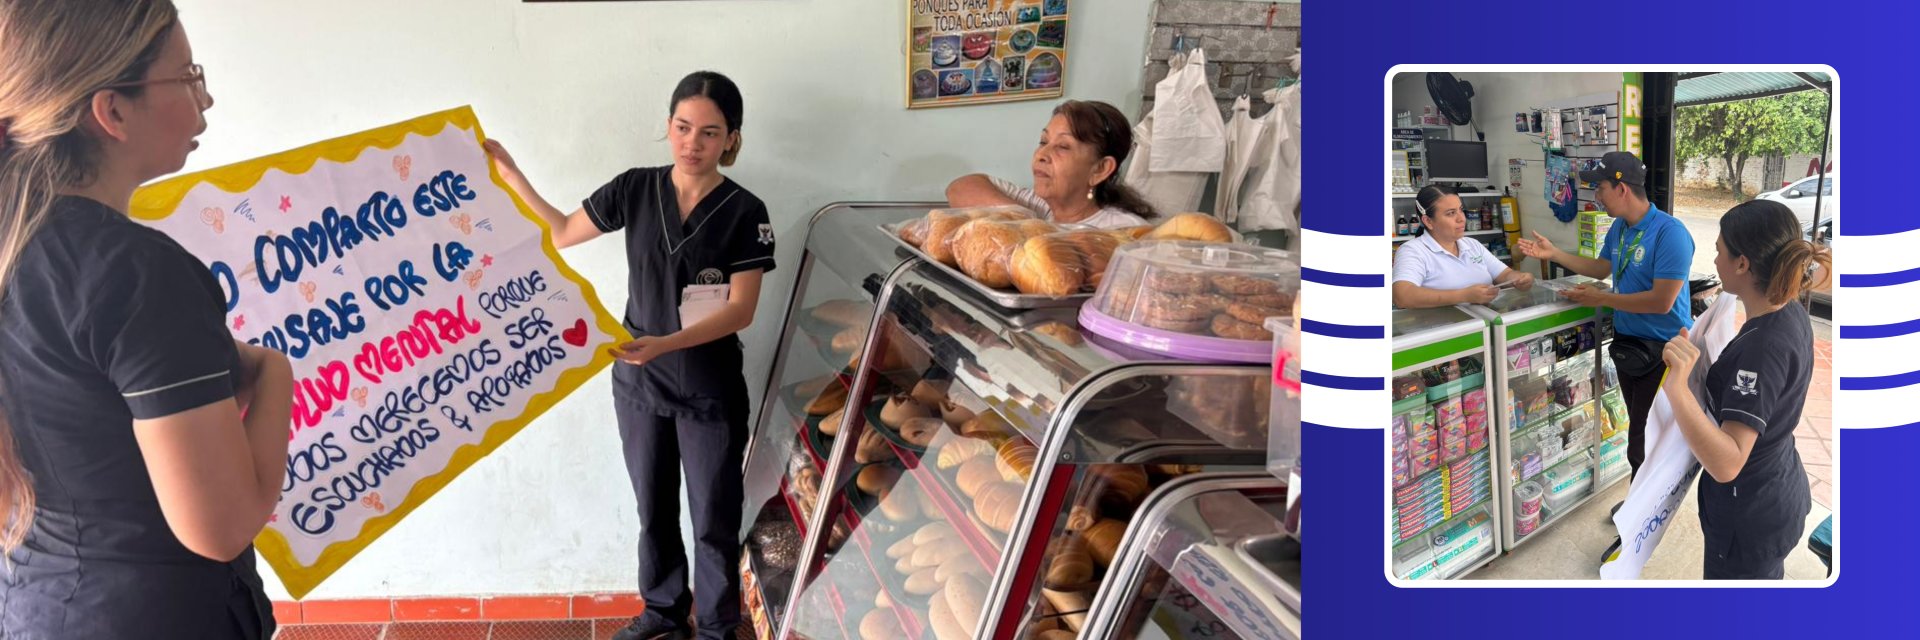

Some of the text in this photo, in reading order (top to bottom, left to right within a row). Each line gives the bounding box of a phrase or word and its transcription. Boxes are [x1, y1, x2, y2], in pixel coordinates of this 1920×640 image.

[914, 0, 989, 14] PONQUES PARA
[934, 7, 1012, 31] TODA OCASIÓN
[210, 170, 476, 312] O COMPARTO ESTE
[247, 241, 473, 359] NSAJE POR LA
[353, 295, 481, 384] MENTAL
[479, 270, 546, 319] PORQUE
[279, 307, 553, 501] DOS MERECEMOS SER
[291, 335, 566, 535] ESCUCHADOS & APOYADOS
